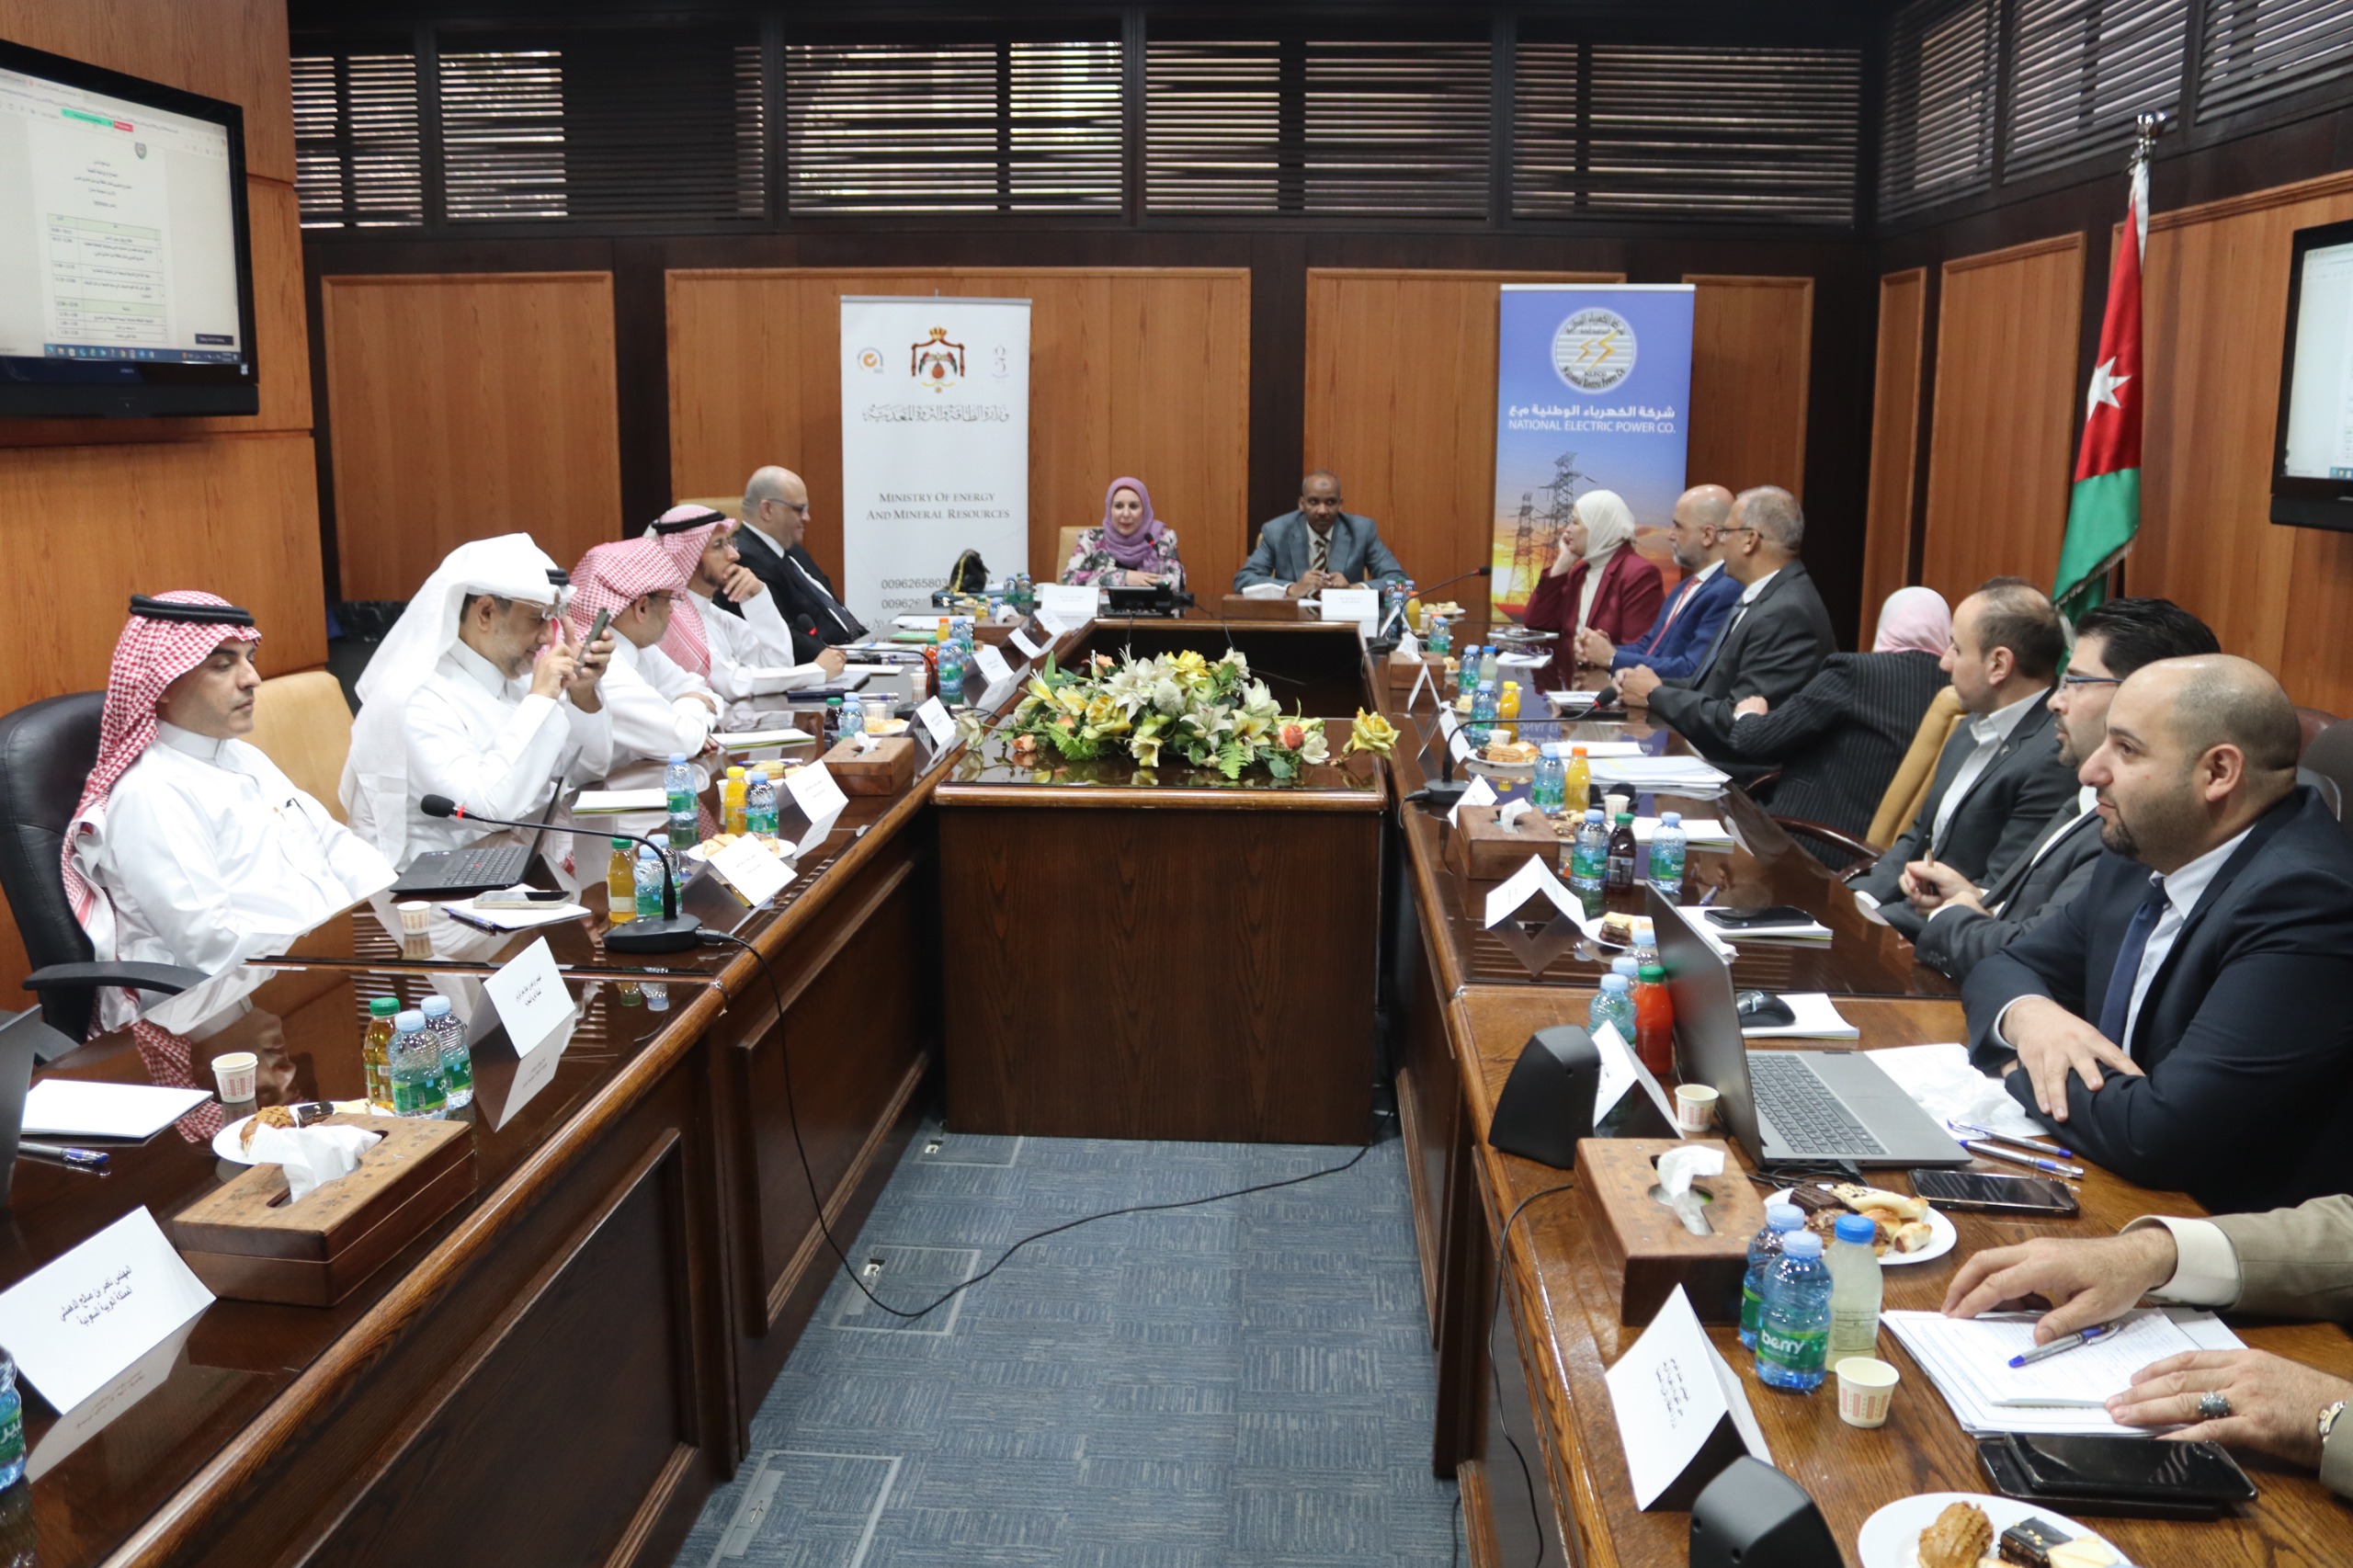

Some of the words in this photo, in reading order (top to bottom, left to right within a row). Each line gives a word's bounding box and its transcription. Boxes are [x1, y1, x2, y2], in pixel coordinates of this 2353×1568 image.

[949, 403, 983, 423] الطاقة
[983, 403, 1010, 423] وزارة
[1531, 404, 1580, 418] الوطنية
[1584, 405, 1636, 419] الكهرباء
[1638, 405, 1676, 420] شركة
[1508, 419, 1562, 430] NATIONAL
[1564, 420, 1615, 432] ELECTRIC
[1616, 421, 1655, 433] POWER
[1657, 423, 1677, 434] CO.
[879, 493, 933, 503] MINISTRY
[948, 509, 1010, 519] RESOURCES
[881, 578, 949, 590] 0096265803
[112, 1285, 133, 1301] المملكة
[97, 1296, 117, 1313] العربية
[1762, 1329, 1805, 1355] berry
